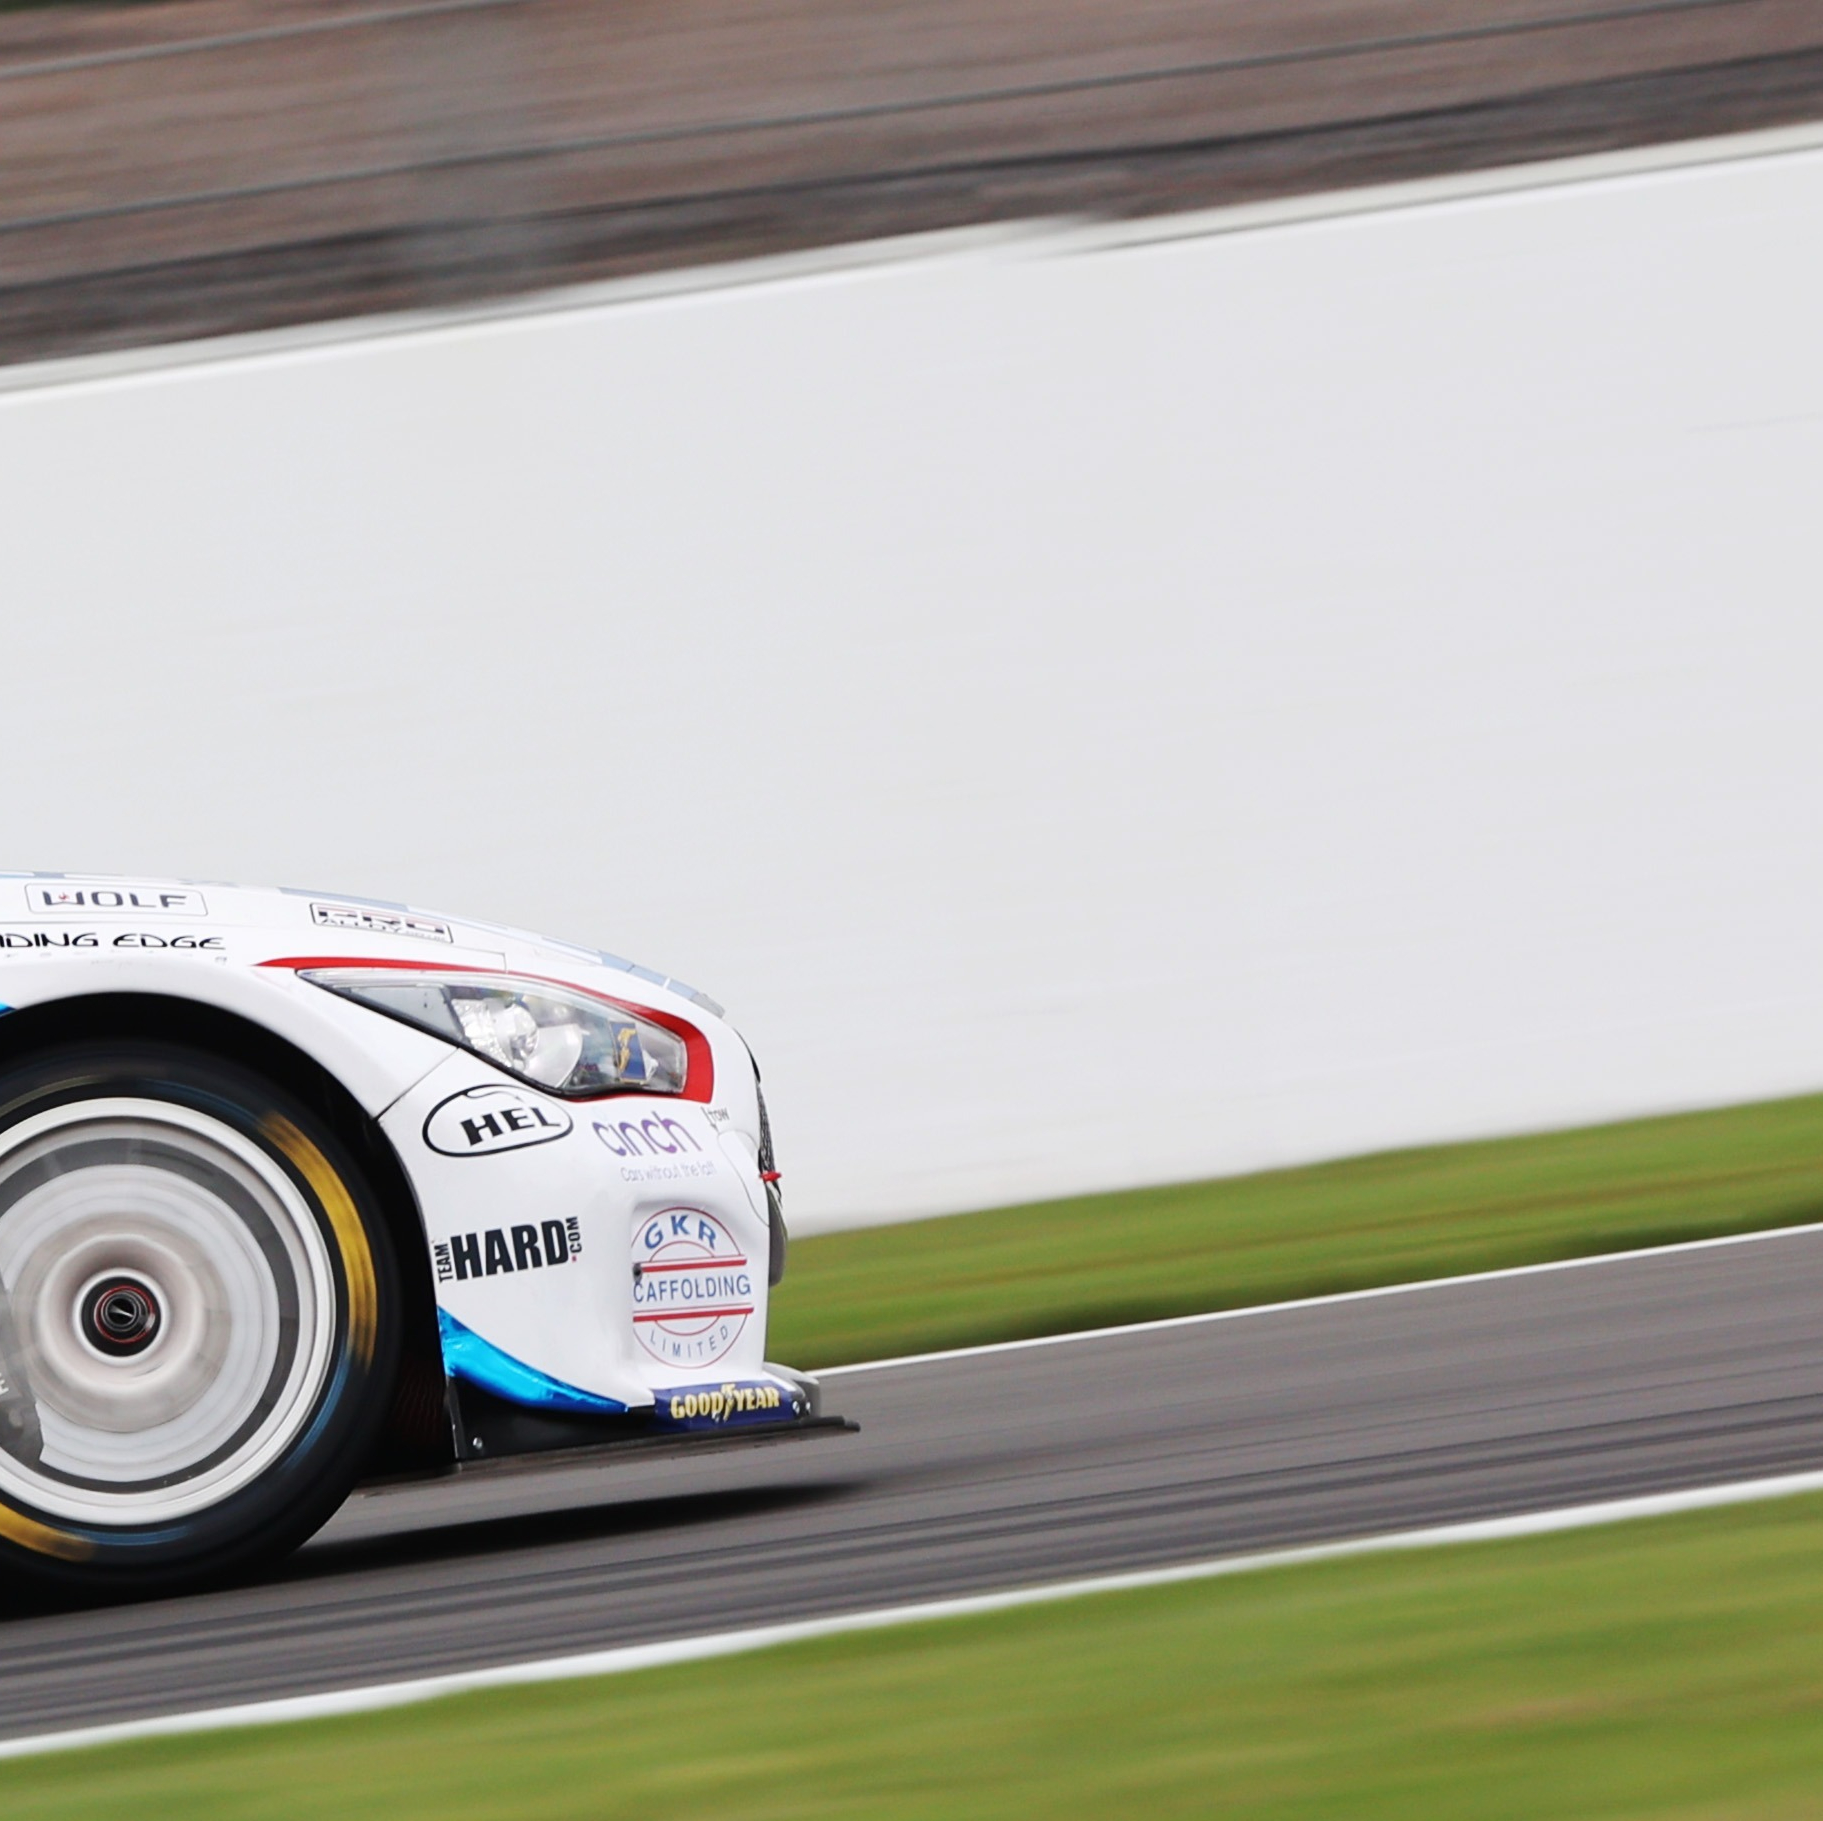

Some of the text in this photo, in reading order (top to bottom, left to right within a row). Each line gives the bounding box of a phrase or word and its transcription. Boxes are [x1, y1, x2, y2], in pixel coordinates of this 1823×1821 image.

[41, 890, 188, 908] WOLF
[112, 933, 226, 950] EDGE
[460, 1106, 561, 1146] HEL
[592, 1110, 704, 1157] cinch
[450, 1219, 569, 1281] HARD
[644, 1214, 717, 1250] GKR
[434, 1243, 453, 1283] TEAM
[650, 1325, 728, 1358] LIMITED
